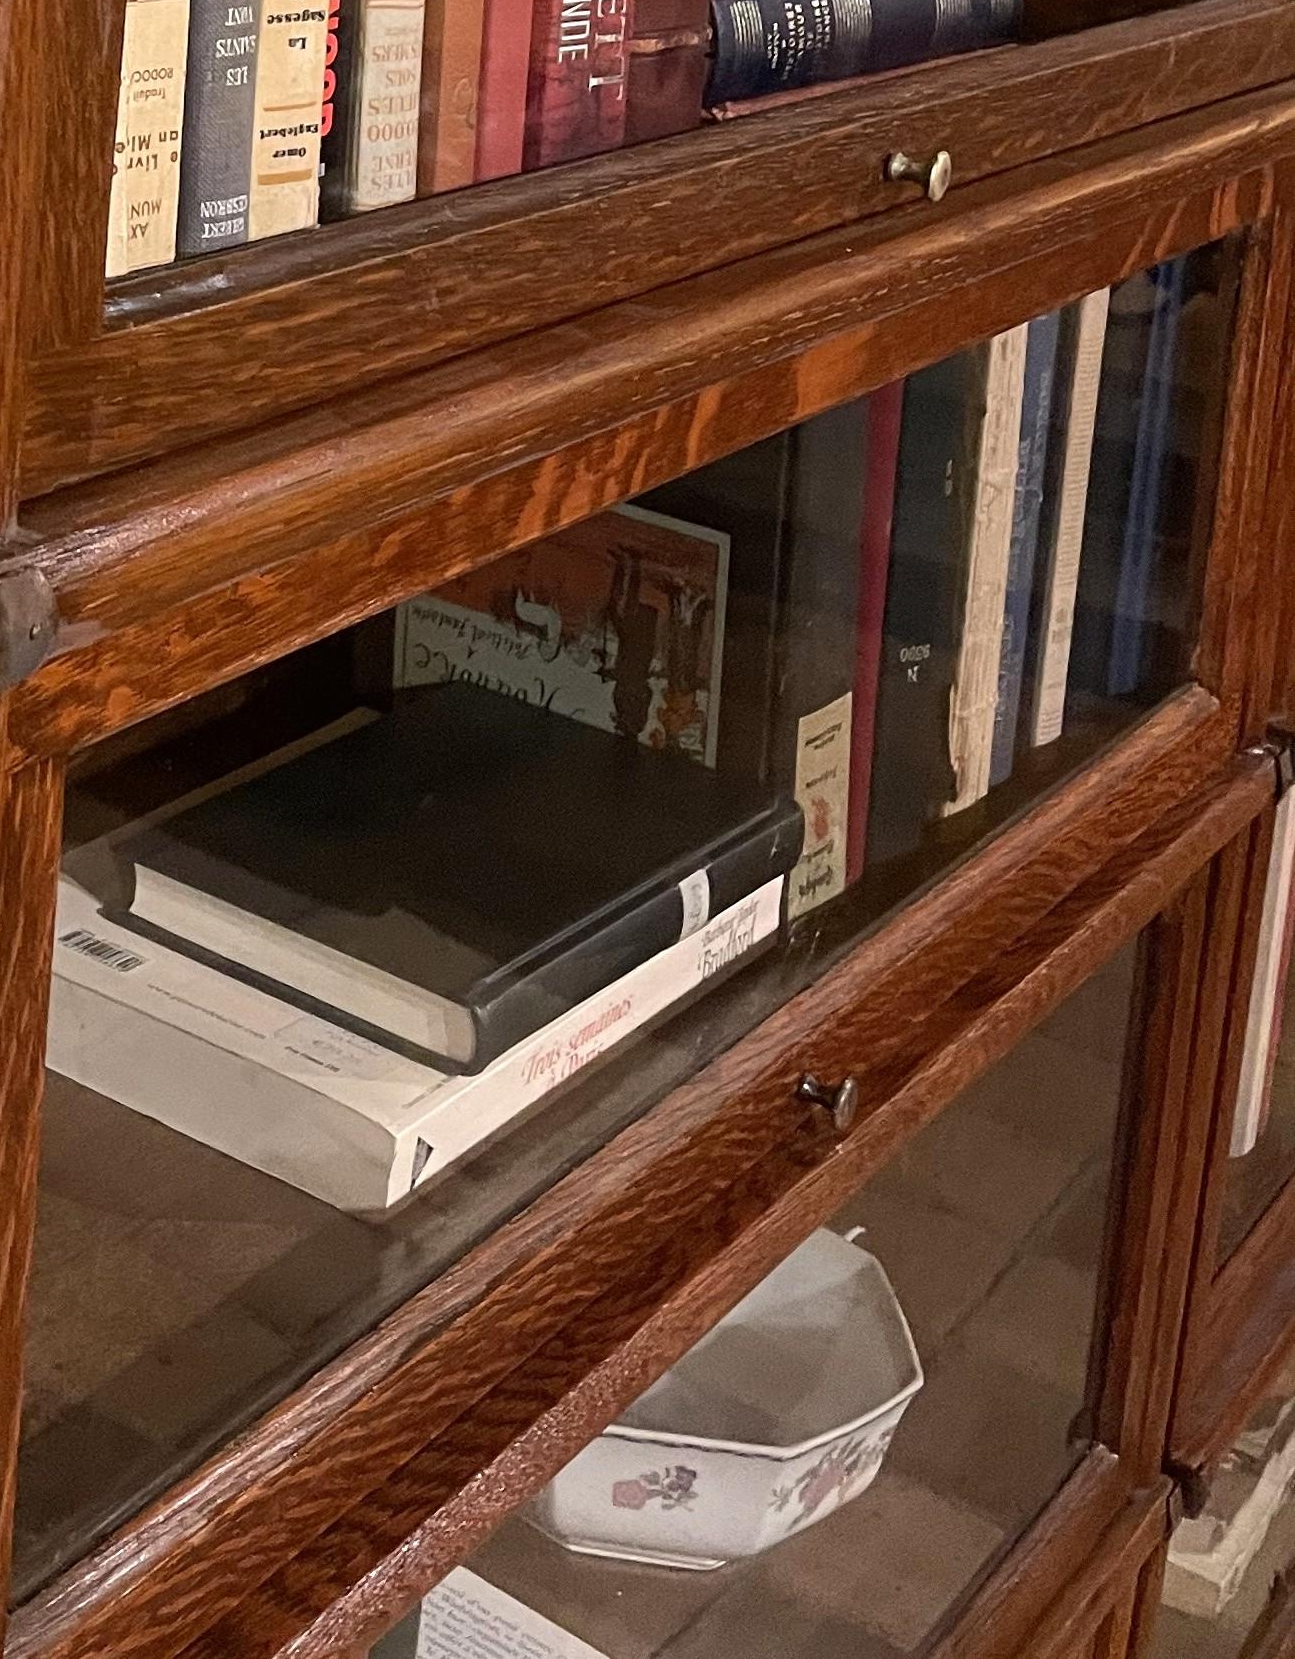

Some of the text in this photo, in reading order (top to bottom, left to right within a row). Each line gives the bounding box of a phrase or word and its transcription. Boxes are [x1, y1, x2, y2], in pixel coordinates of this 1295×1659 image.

[267, 9, 325, 25] Sagesse
[288, 37, 307, 50] La
[259, 123, 320, 140] Englebert
[272, 146, 307, 159] Omer
[521, 994, 634, 1085] Trois semaines
